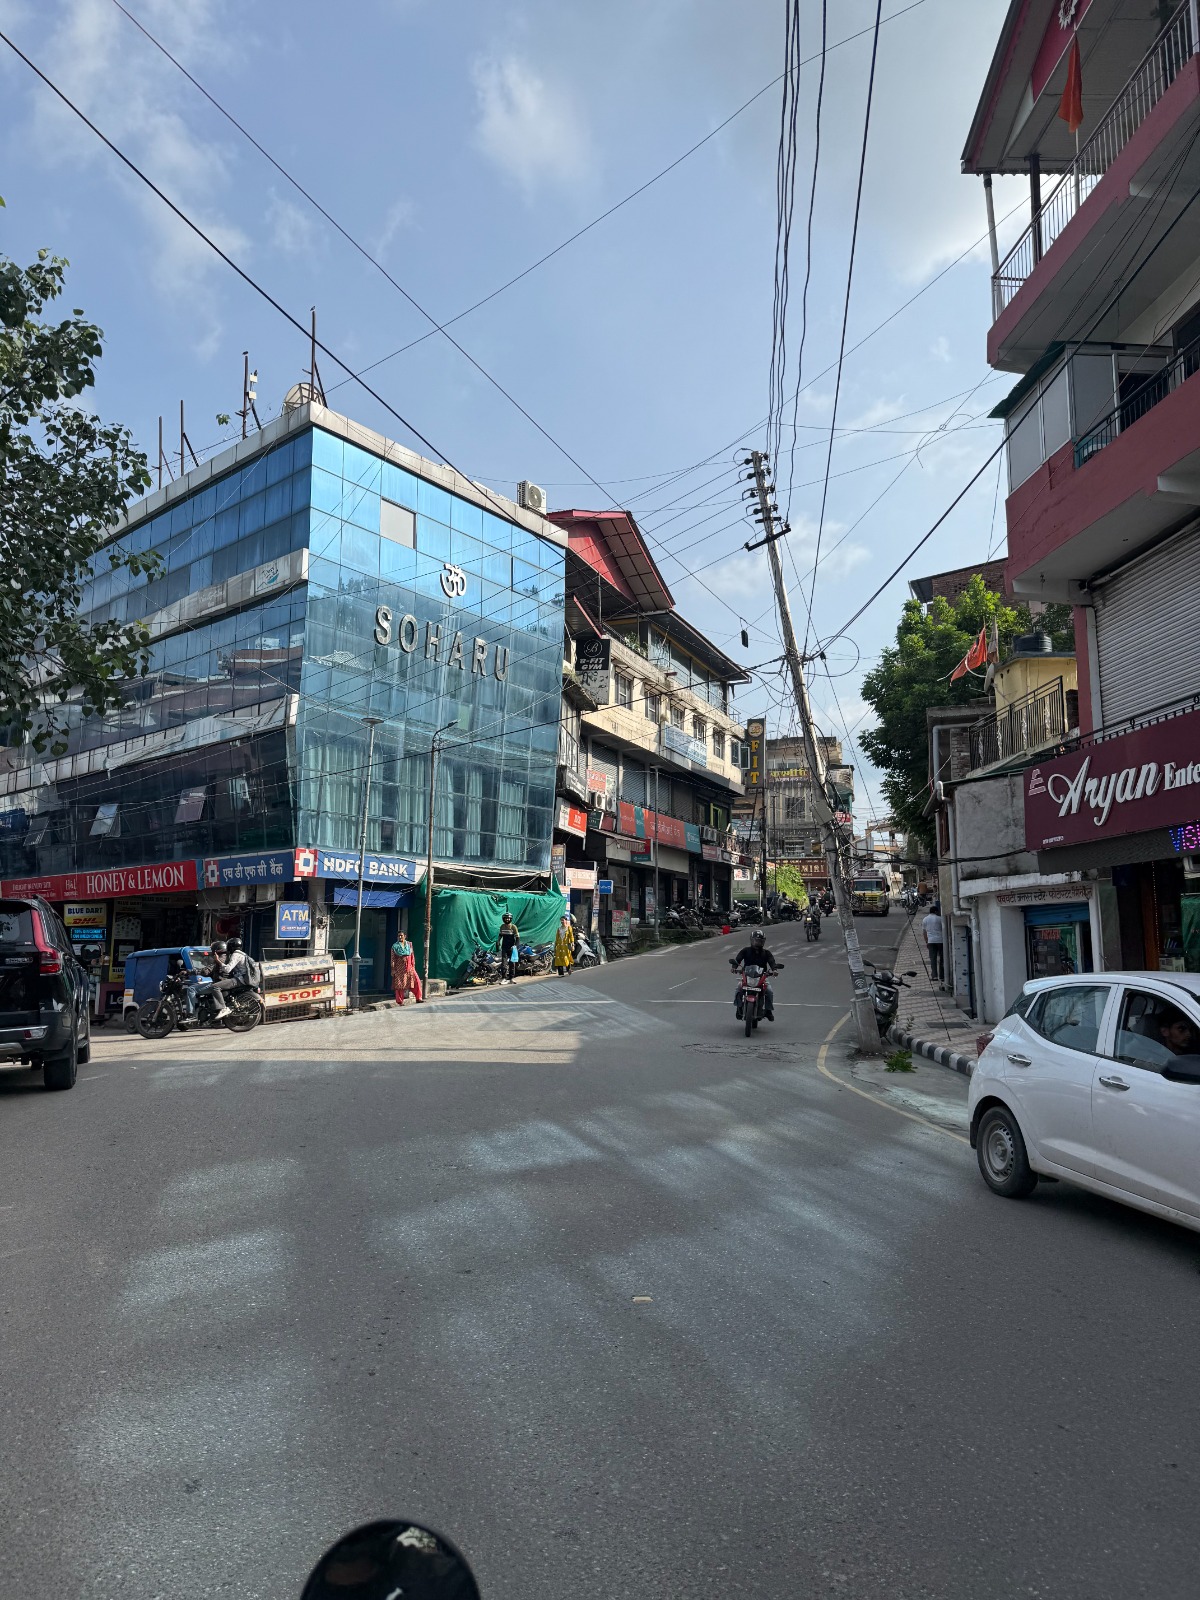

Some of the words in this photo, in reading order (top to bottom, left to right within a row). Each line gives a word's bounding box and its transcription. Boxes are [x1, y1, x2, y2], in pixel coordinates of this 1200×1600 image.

[374, 605, 510, 682] SOHARU
[1047, 755, 1162, 826] Aryan
[86, 871, 127, 894] HONEY
[128, 873, 135, 889] &
[137, 865, 185, 890] LEMON
[222, 867, 233, 881] एच
[234, 862, 243, 878] डी
[244, 865, 255, 880] एफ
[257, 860, 267, 876] सी
[269, 858, 283, 875] बैंक
[369, 861, 409, 877] BANK
[282, 909, 308, 921] ATM
[278, 989, 322, 1002] STOP
